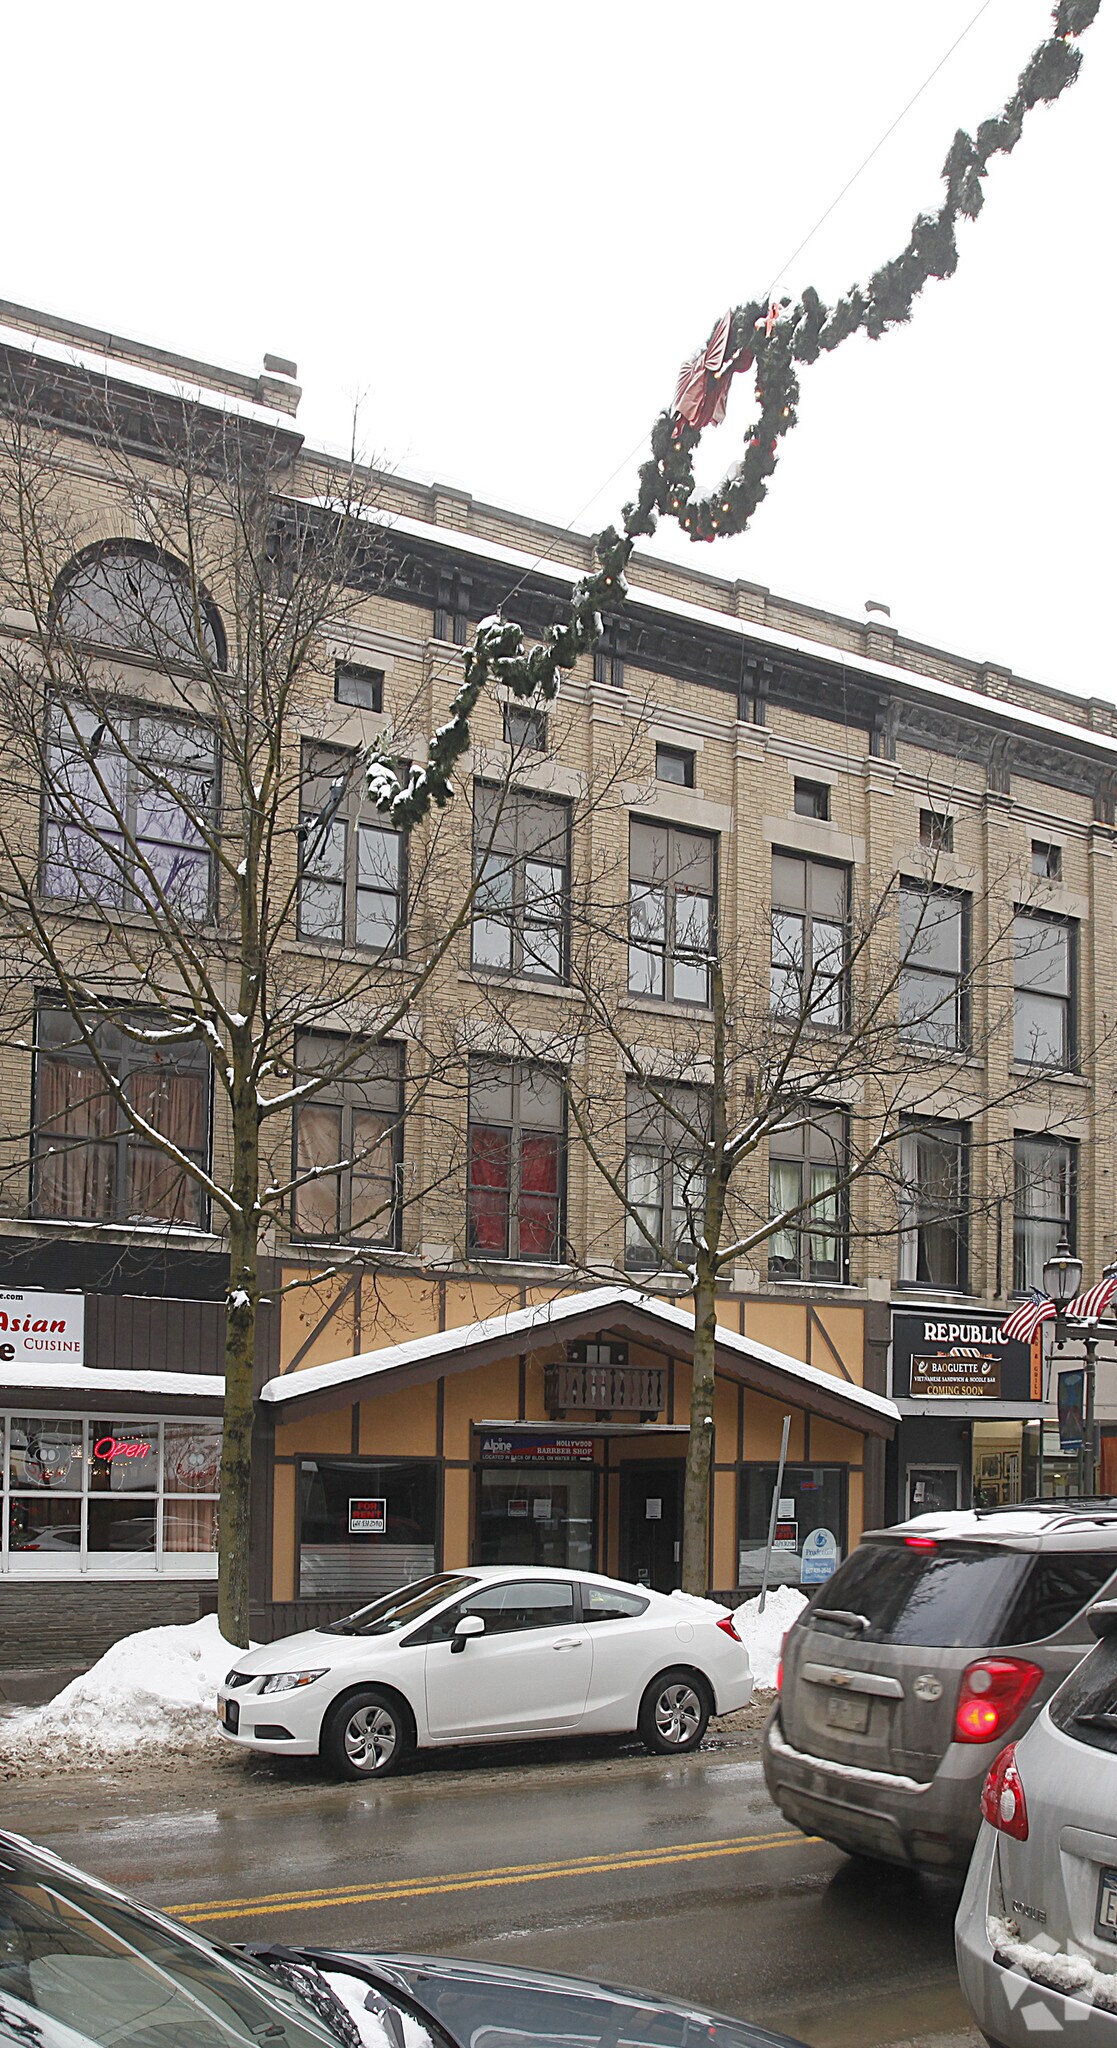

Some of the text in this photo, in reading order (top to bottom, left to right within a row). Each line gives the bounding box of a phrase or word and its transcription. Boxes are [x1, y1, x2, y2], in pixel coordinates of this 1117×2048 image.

[924, 1322, 1009, 1344] REPUBLIC
[24, 1338, 80, 1352] CUISINE
[927, 1385, 984, 1395] COMING SOON
[94, 1437, 150, 1460] Open
[483, 1438, 512, 1453] Alpine
[357, 1502, 377, 1511] FOR
[1011, 1898, 1047, 1924] ROGUE
